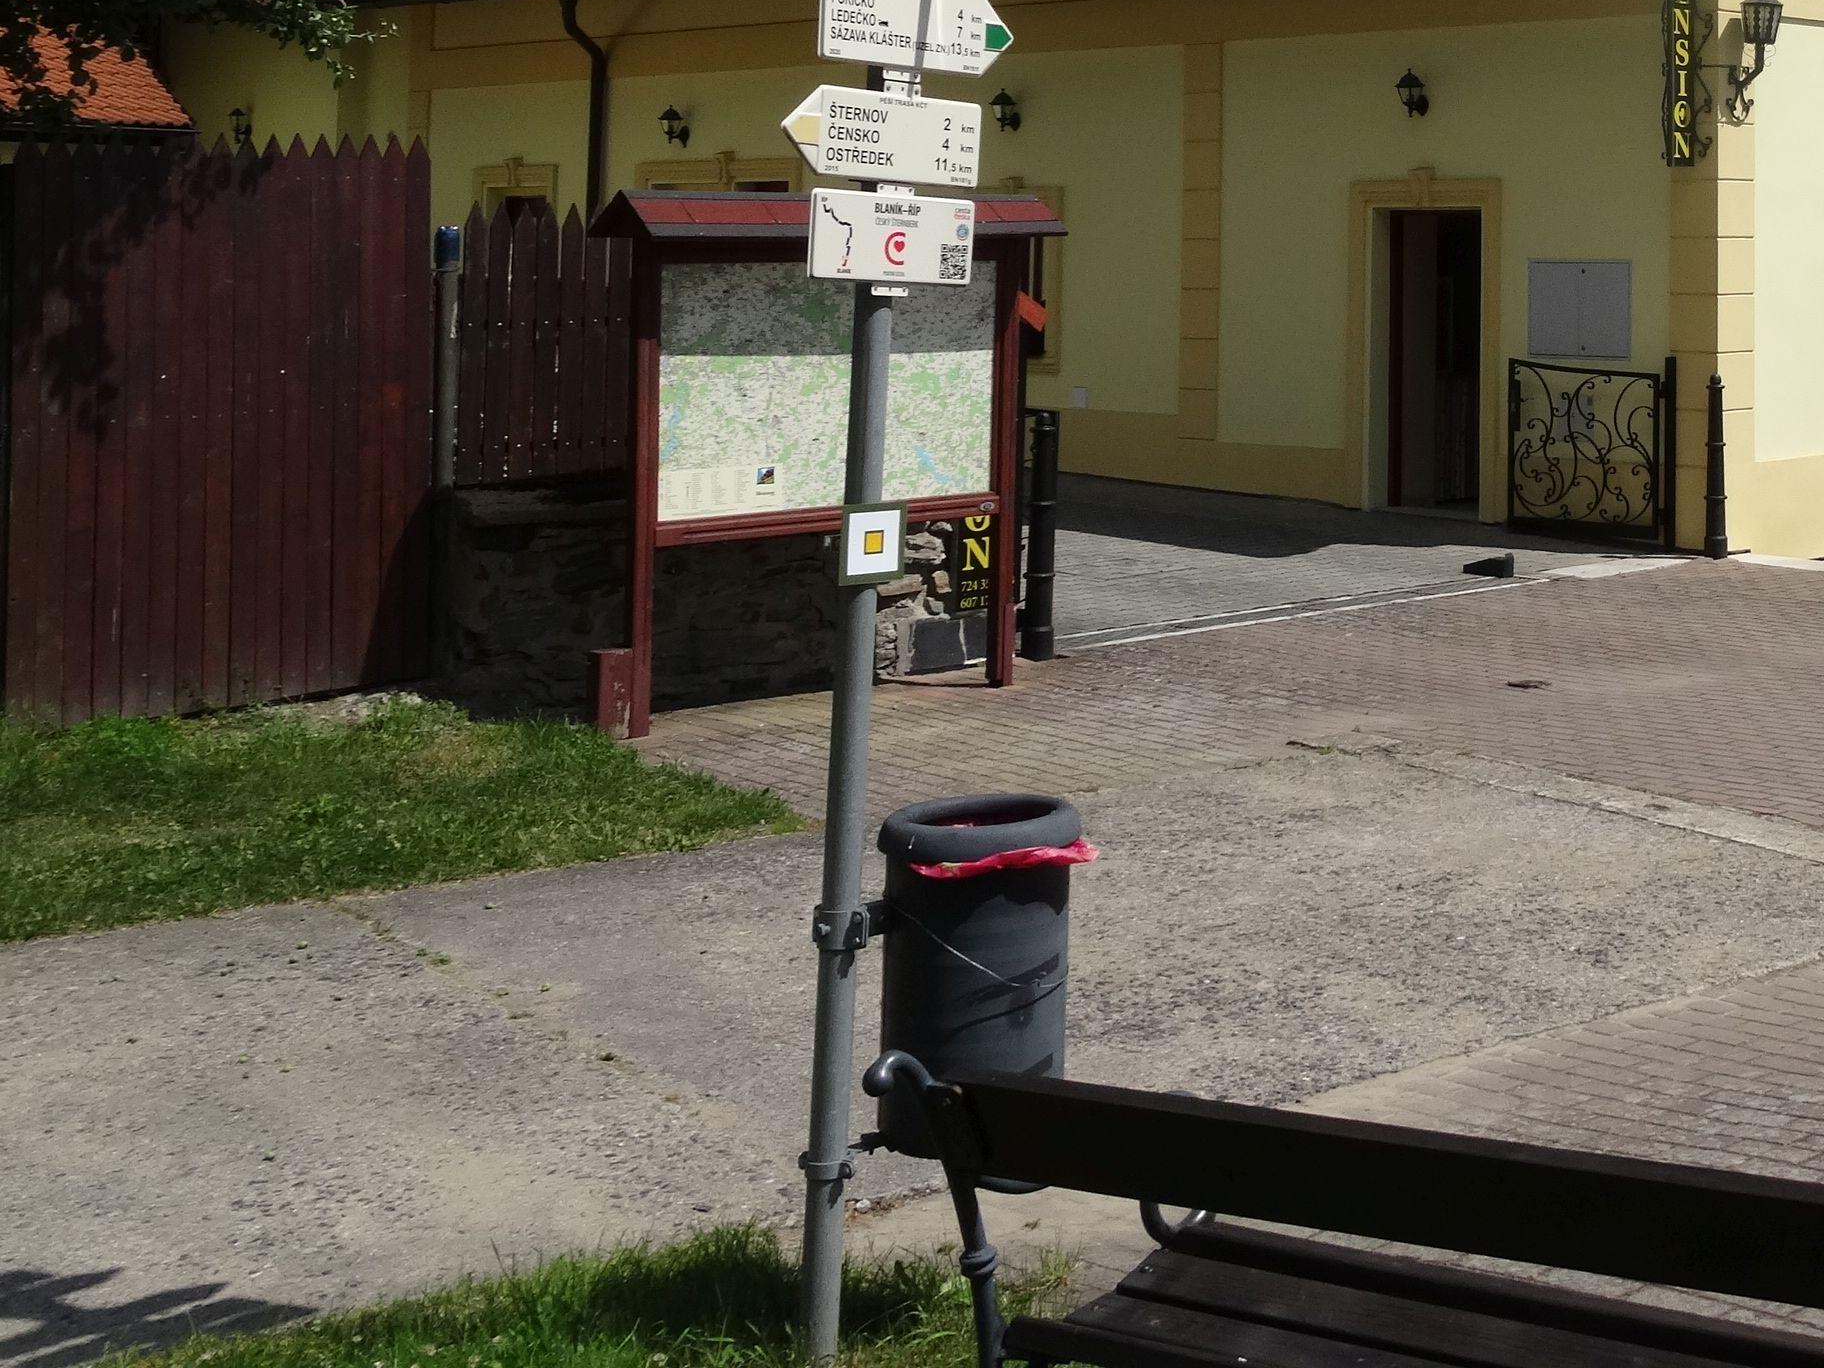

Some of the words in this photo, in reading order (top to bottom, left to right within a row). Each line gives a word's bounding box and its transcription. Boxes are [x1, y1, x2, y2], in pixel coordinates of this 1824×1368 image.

[831, 8, 876, 26] LEDEČKO
[957, 9, 964, 21] 4
[971, 14, 982, 24] km
[830, 24, 867, 44] SÁZAVA
[869, 28, 911, 49] KLÁŠTER
[957, 26, 963, 38] 7
[970, 31, 981, 41] km
[970, 49, 981, 58] km
[894, 98, 915, 108] TRASA
[829, 101, 889, 124] ŠTERNOV
[828, 122, 880, 144] ČENSKO
[943, 118, 951, 131] 2
[961, 123, 975, 134] km
[942, 138, 950, 152] 4
[960, 144, 974, 154] km
[826, 146, 894, 167] OSTŘEDEK
[959, 163, 973, 173] km
[960, 596, 978, 609] 607
